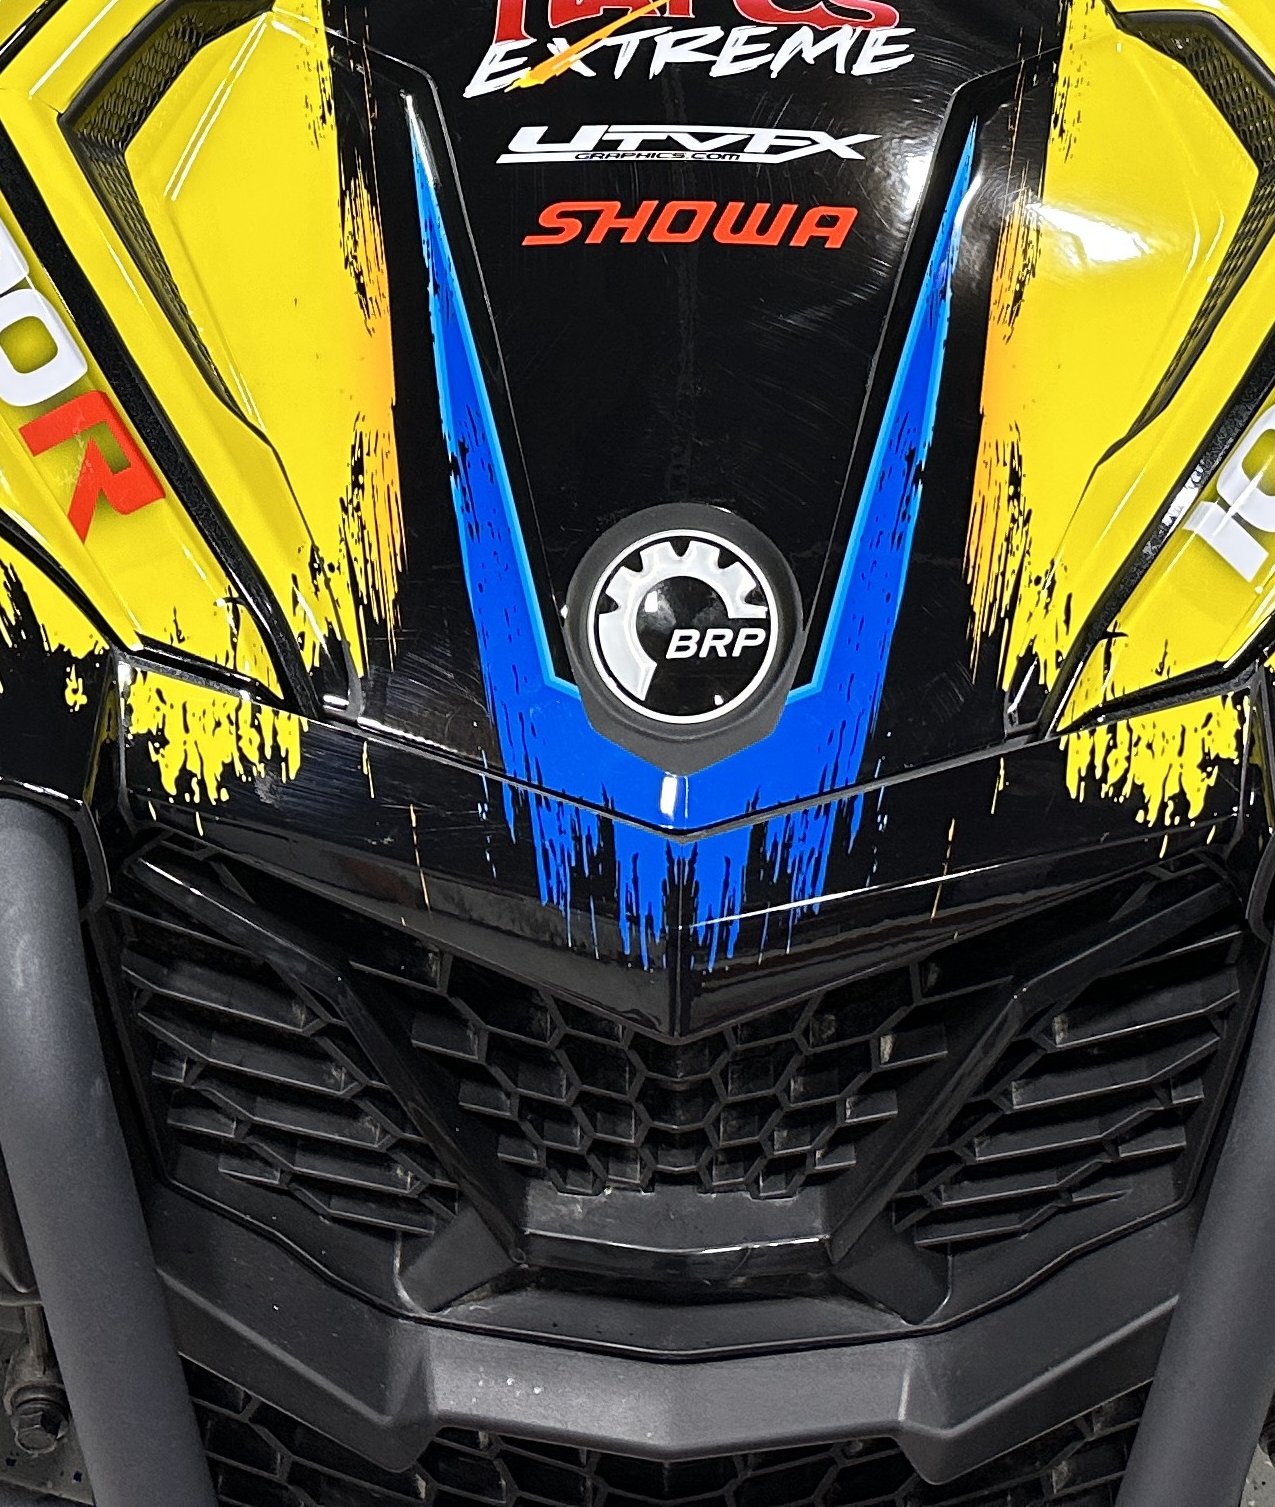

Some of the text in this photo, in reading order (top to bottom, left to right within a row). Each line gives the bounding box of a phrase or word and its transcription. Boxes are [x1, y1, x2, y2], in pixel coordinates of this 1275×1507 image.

[463, 24, 916, 98] EXTREME
[575, 151, 741, 161] GRAPHICS.COM
[521, 199, 859, 249] SHOWA
[665, 627, 766, 659] BRP
